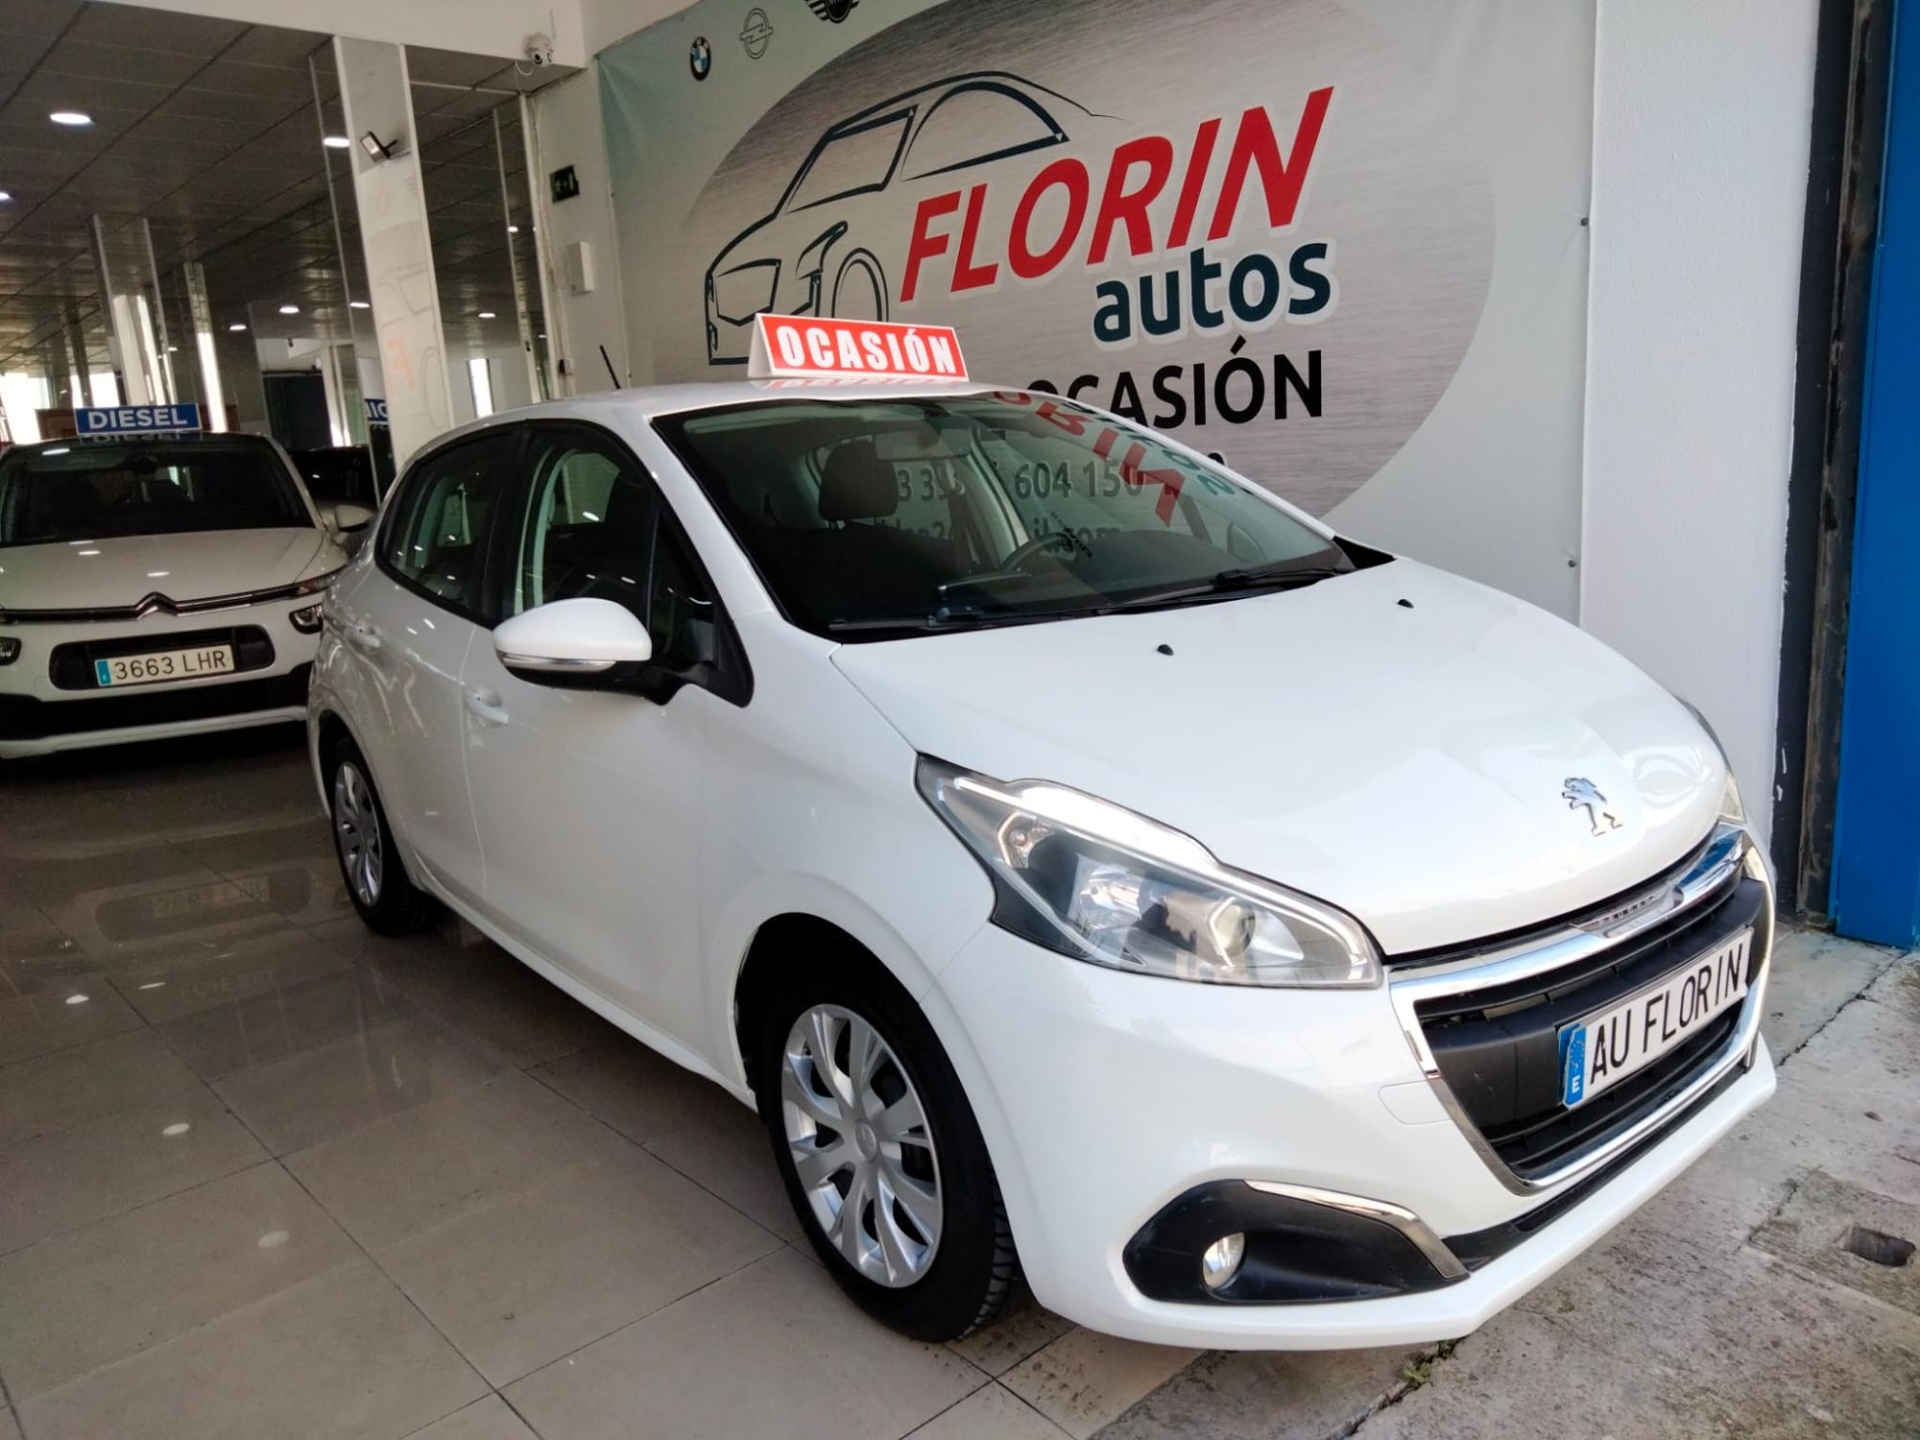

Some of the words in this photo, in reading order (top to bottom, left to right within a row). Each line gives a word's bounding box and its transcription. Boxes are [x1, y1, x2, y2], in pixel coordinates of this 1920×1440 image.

[900, 86, 1334, 303] FLORIN
[1093, 243, 1331, 342] autos
[776, 326, 957, 373] OCASIÓN
[88, 408, 188, 429] DIESEL
[1015, 462, 1071, 500] 604
[114, 656, 174, 680] 3663
[182, 650, 227, 672] LHR
[1590, 1009, 1632, 1085] AU
[1642, 943, 1743, 1054] FLORIN
[1571, 1074, 1581, 1093] E
